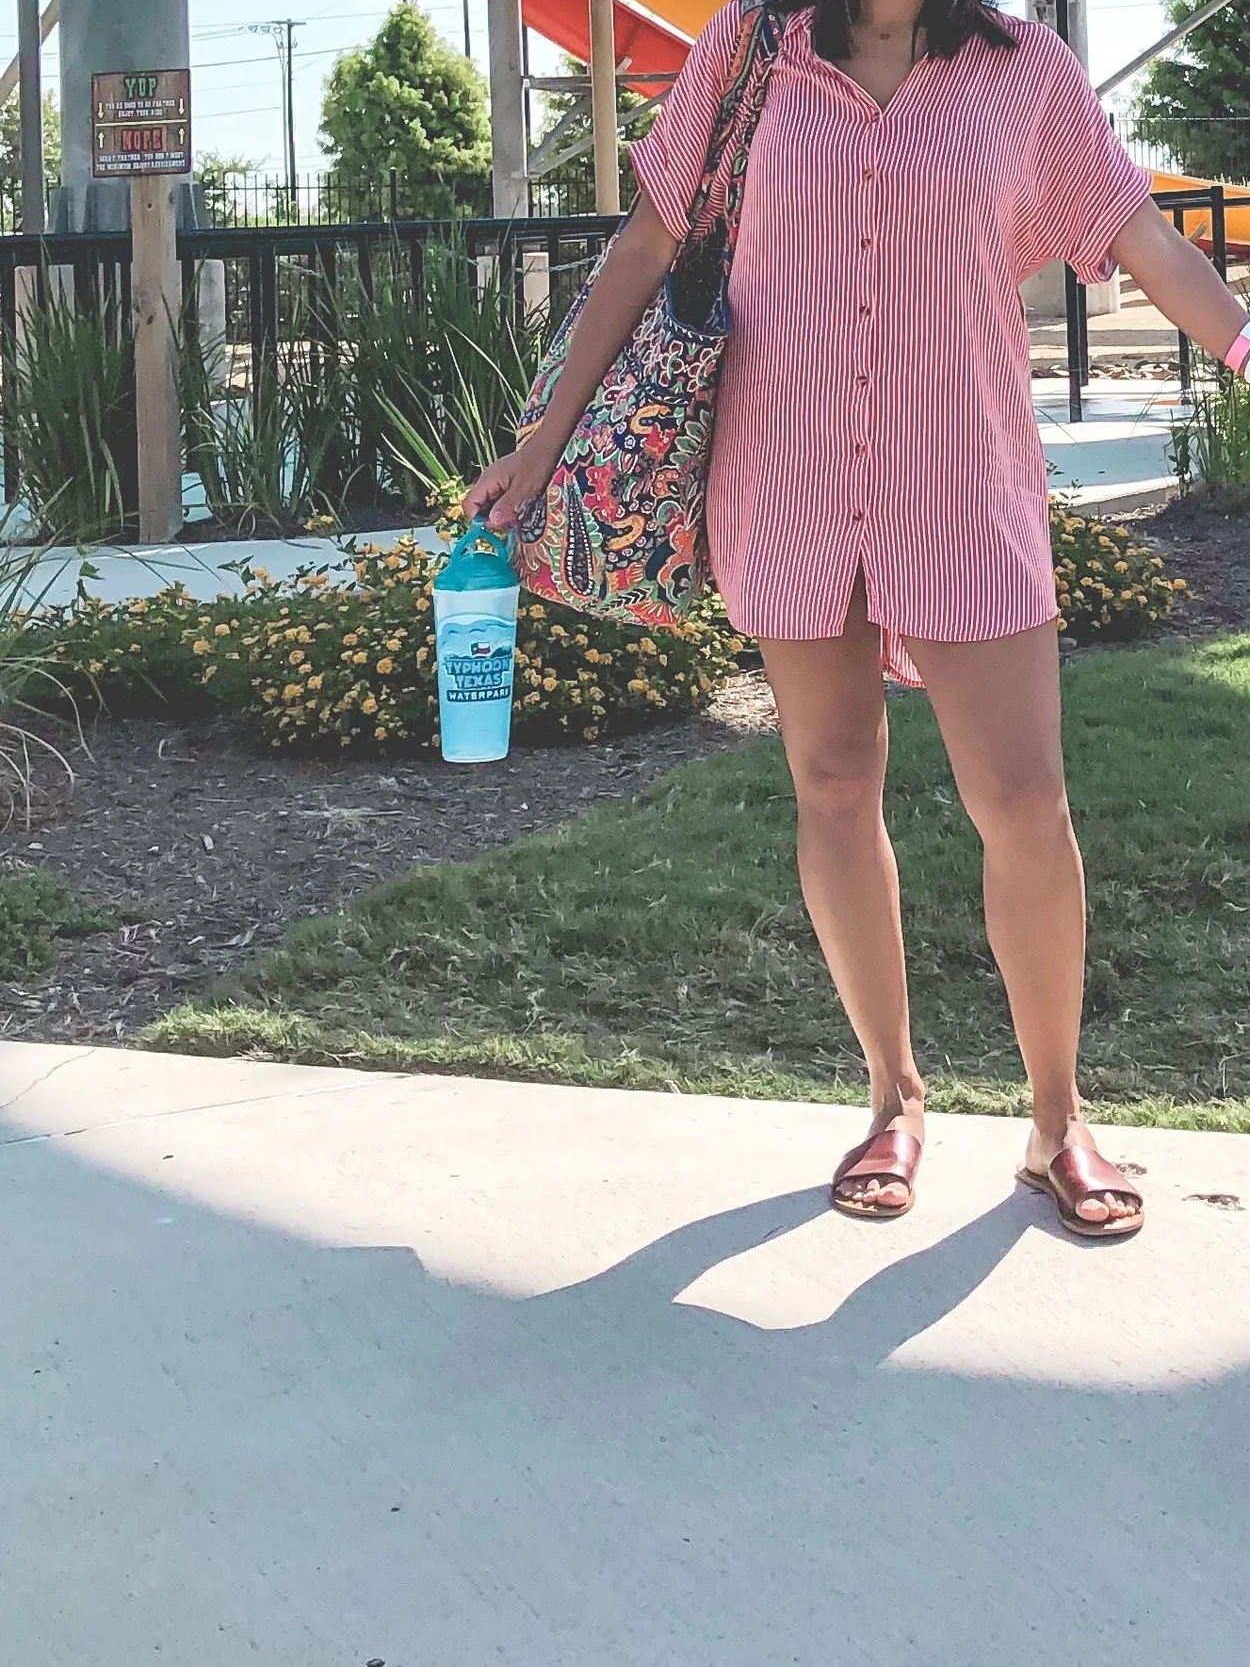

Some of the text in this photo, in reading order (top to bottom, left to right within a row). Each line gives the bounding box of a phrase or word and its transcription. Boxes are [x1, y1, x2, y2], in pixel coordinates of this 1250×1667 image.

[121, 128, 163, 152] NOPE
[446, 658, 510, 674] TYPHOON
[456, 673, 502, 688] TEXAS
